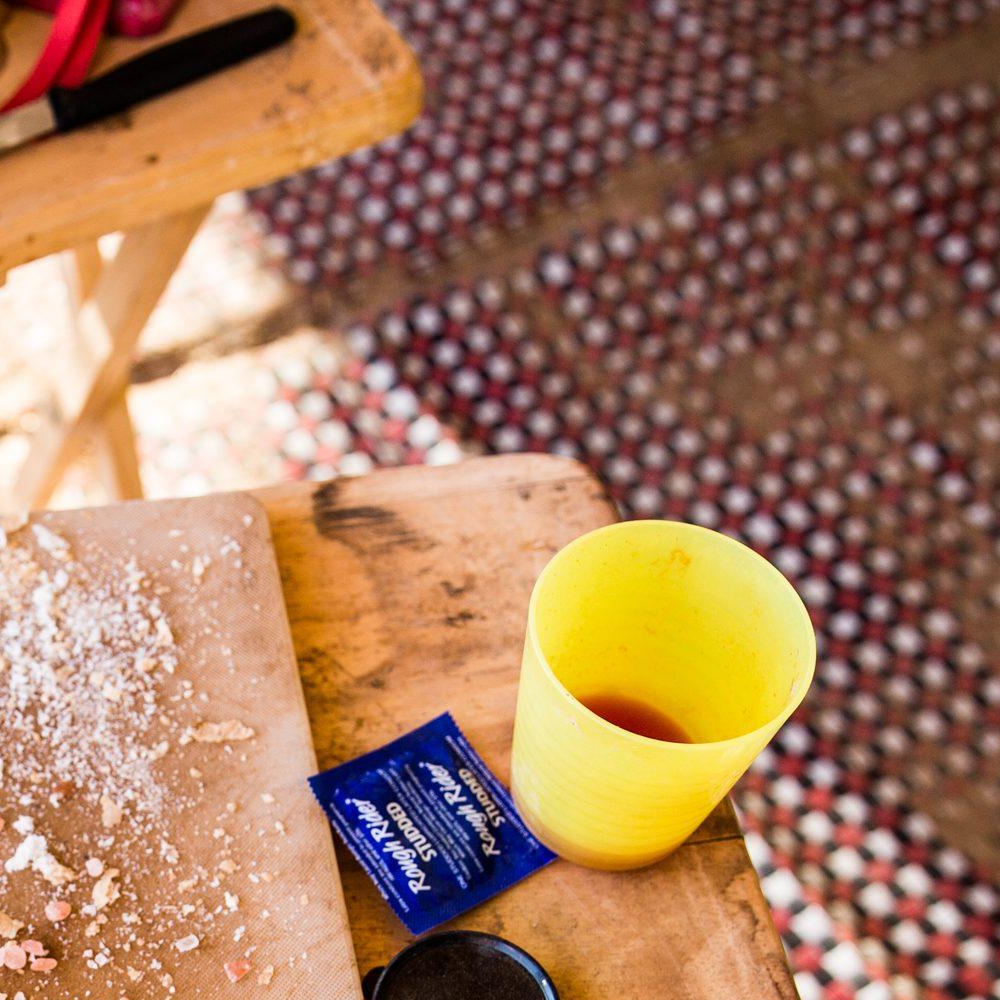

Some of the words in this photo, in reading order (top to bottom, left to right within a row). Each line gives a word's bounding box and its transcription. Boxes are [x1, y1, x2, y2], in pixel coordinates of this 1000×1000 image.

[425, 762, 466, 805] Rider
[459, 768, 506, 828] STUDDED
[352, 798, 394, 843] Rider
[386, 802, 437, 862] STUDDED
[457, 804, 501, 857] Rough
[383, 835, 431, 894] Rough
